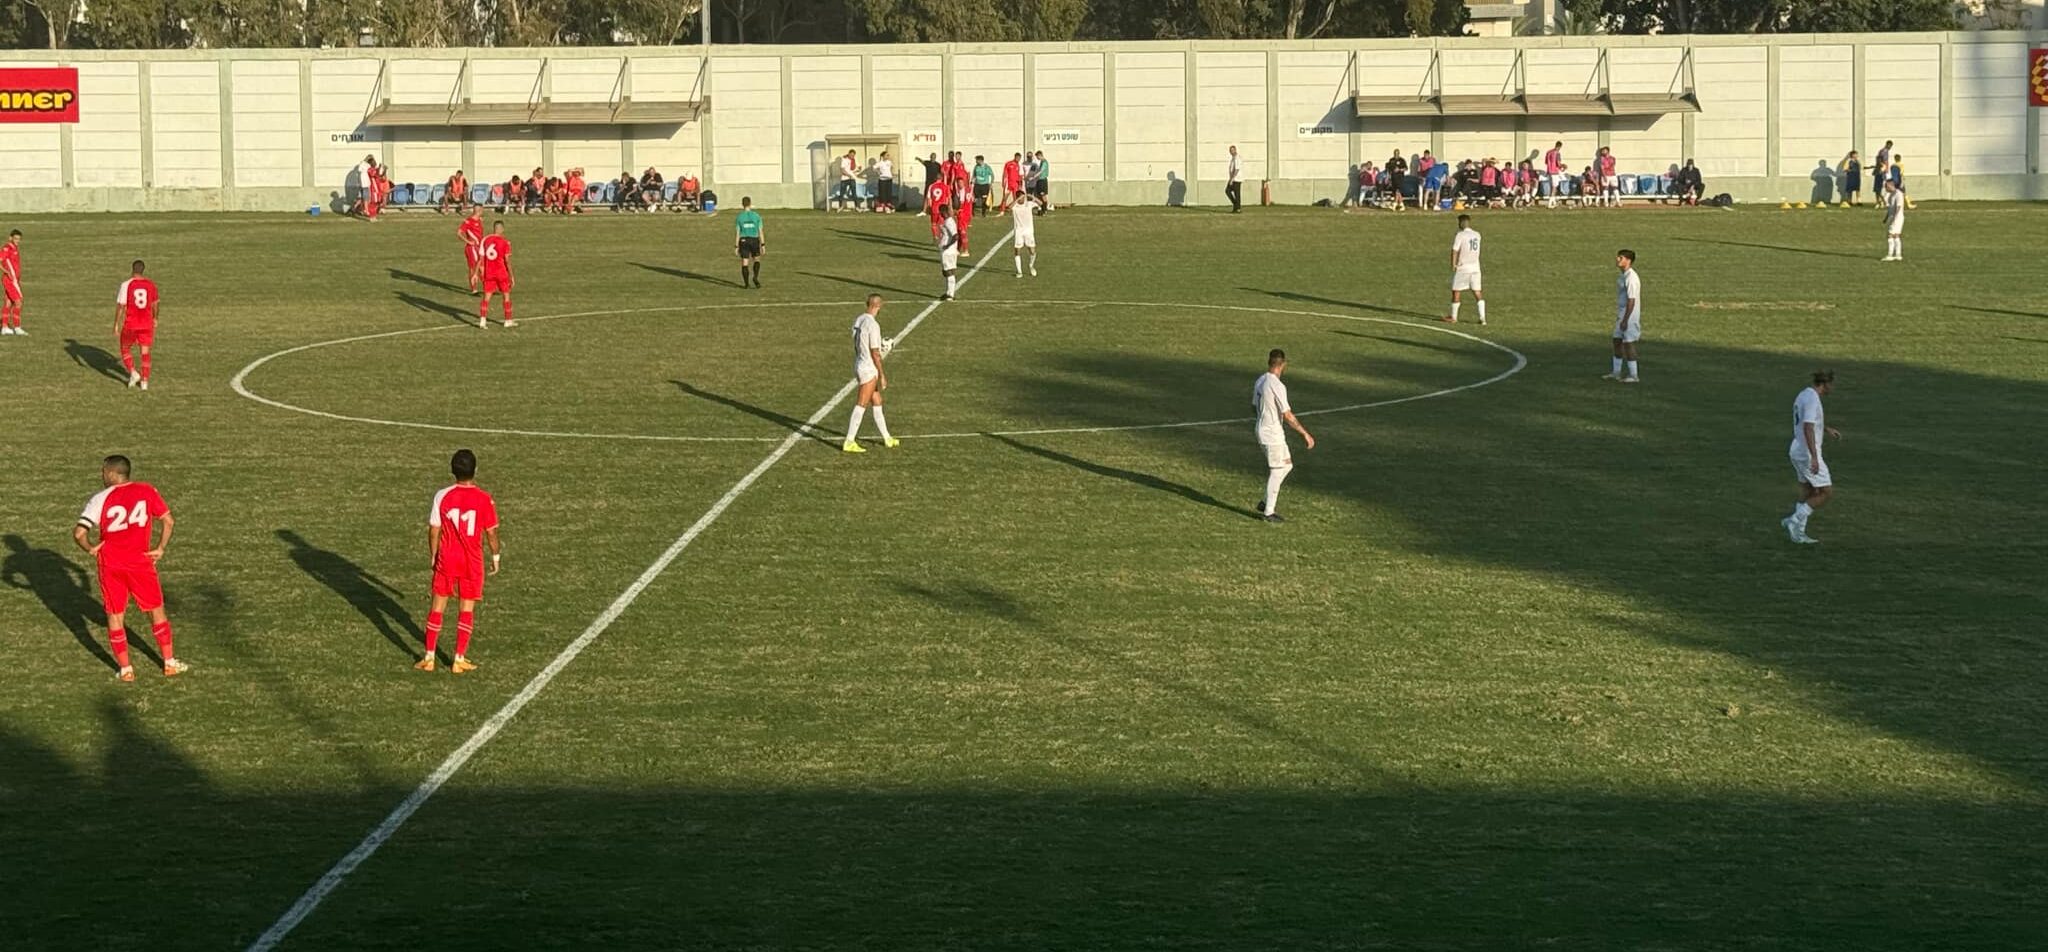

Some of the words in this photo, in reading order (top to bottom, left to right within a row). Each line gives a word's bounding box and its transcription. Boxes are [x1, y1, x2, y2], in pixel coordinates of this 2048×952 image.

[933, 188, 943, 201] 9
[486, 243, 498, 261] 6
[1469, 238, 1478, 251] 16
[133, 288, 148, 310] 8
[106, 500, 148, 533] 24
[446, 507, 477, 537] 11
